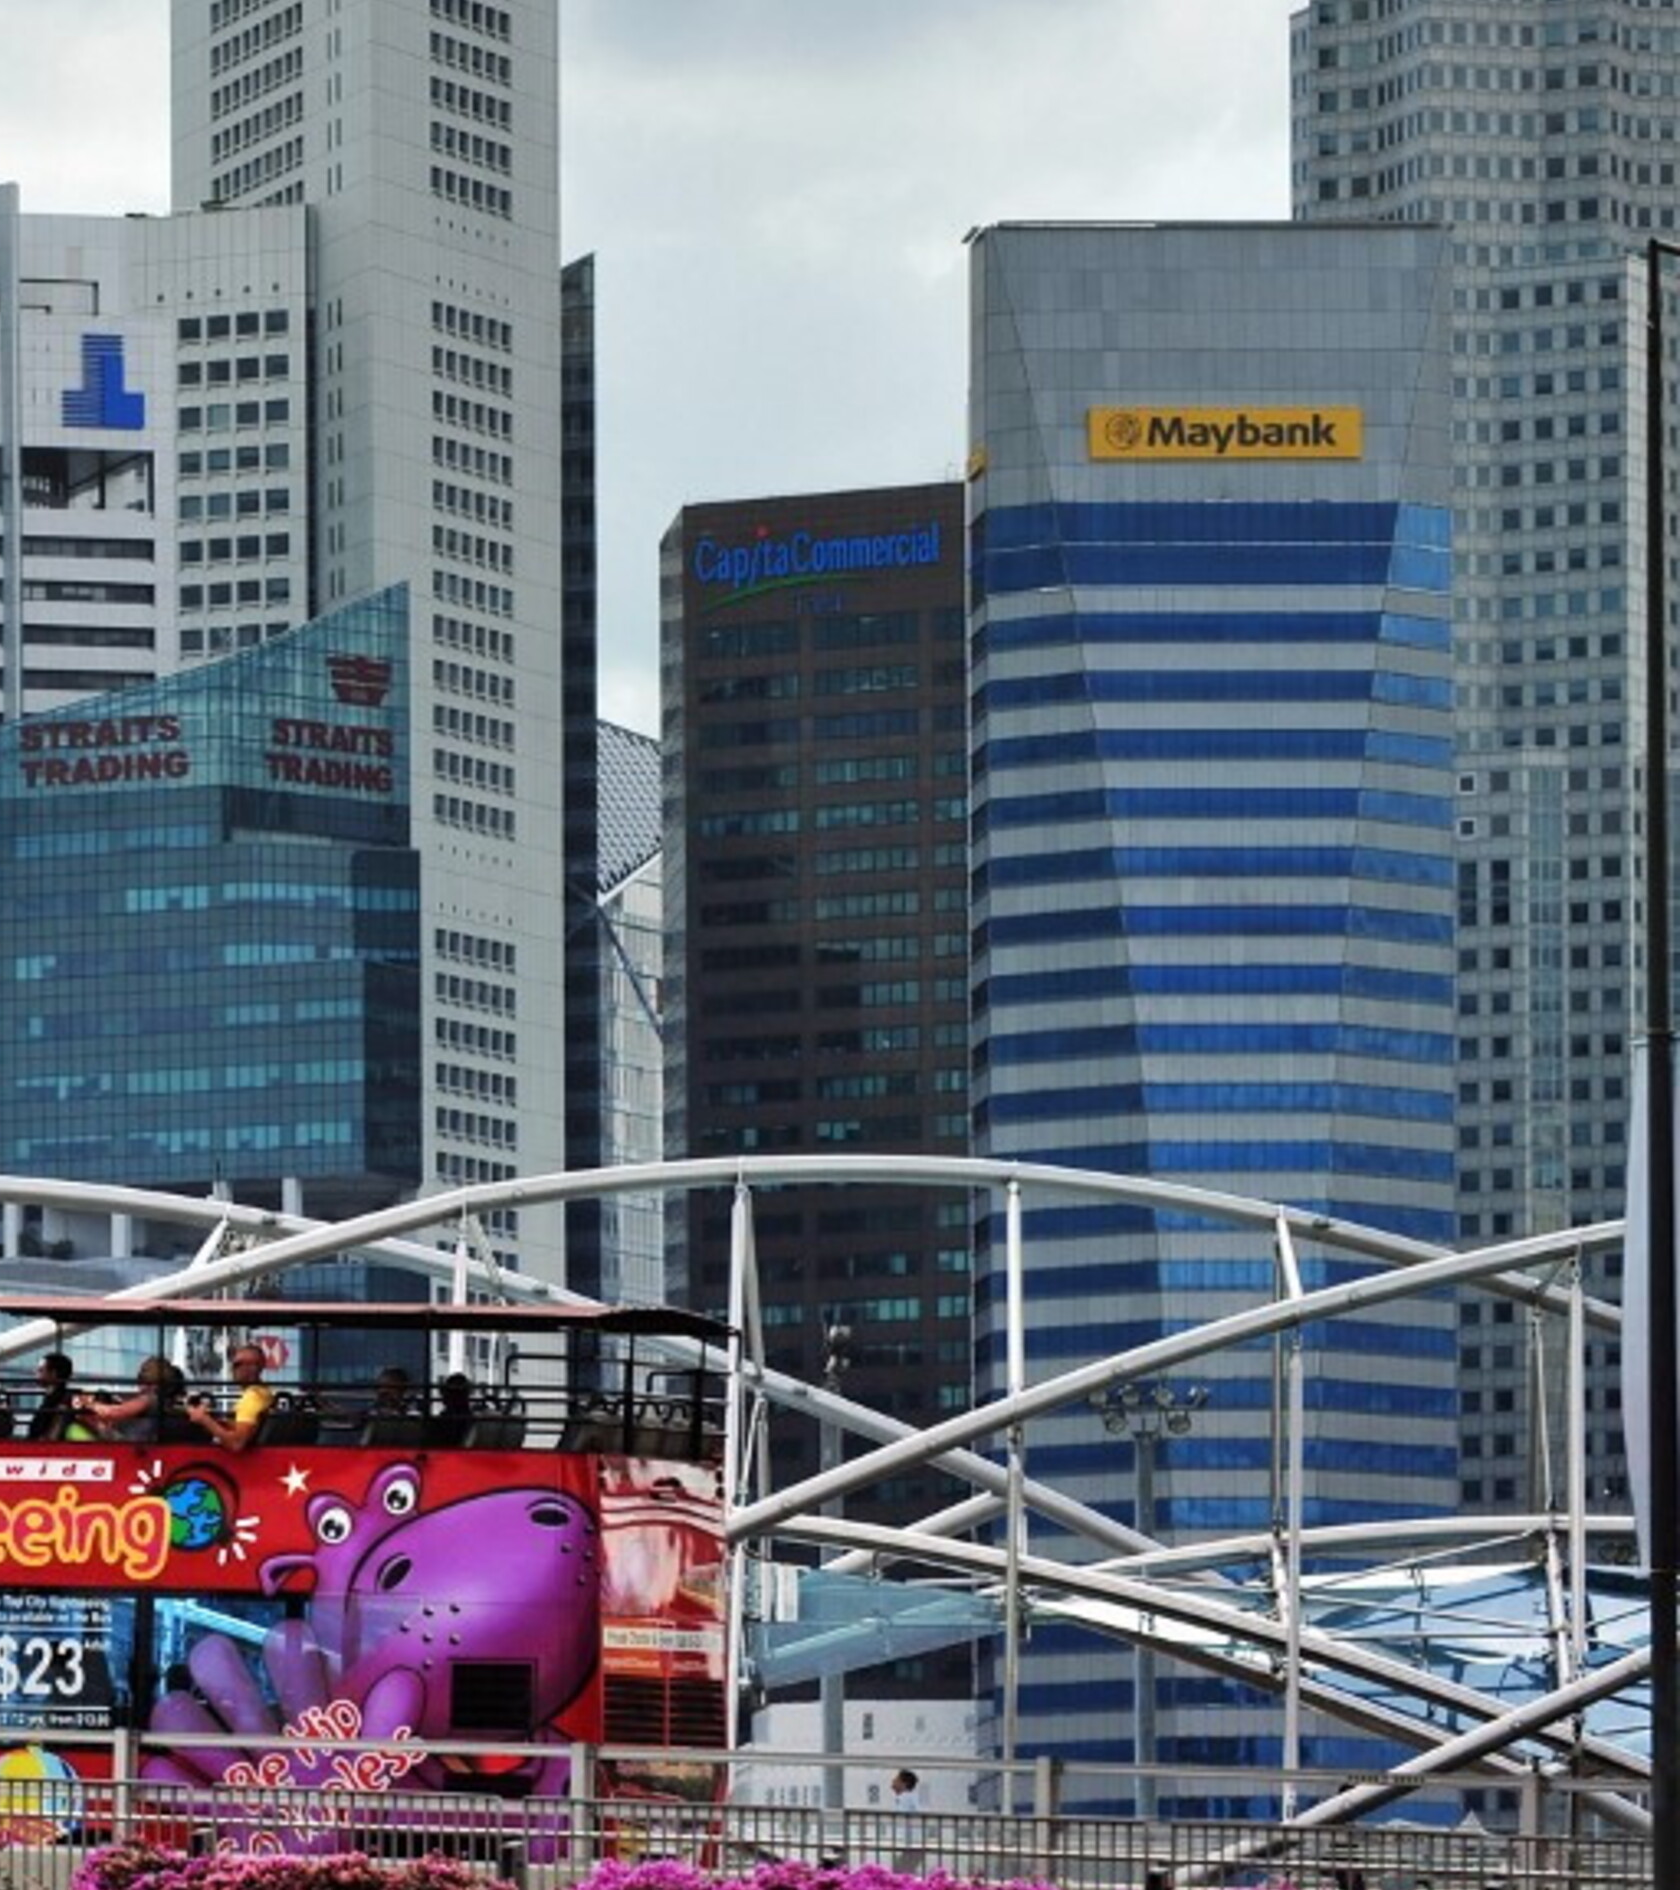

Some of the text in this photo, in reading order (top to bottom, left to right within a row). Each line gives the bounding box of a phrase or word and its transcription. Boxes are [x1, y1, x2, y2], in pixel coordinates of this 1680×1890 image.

[1148, 413, 1336, 453] Maybank
[22, 714, 179, 751] STRAITS
[272, 718, 393, 757] STRAITS
[21, 750, 189, 788] TRADING
[265, 753, 393, 792] TRADING
[26, 1595, 47, 1609] City
